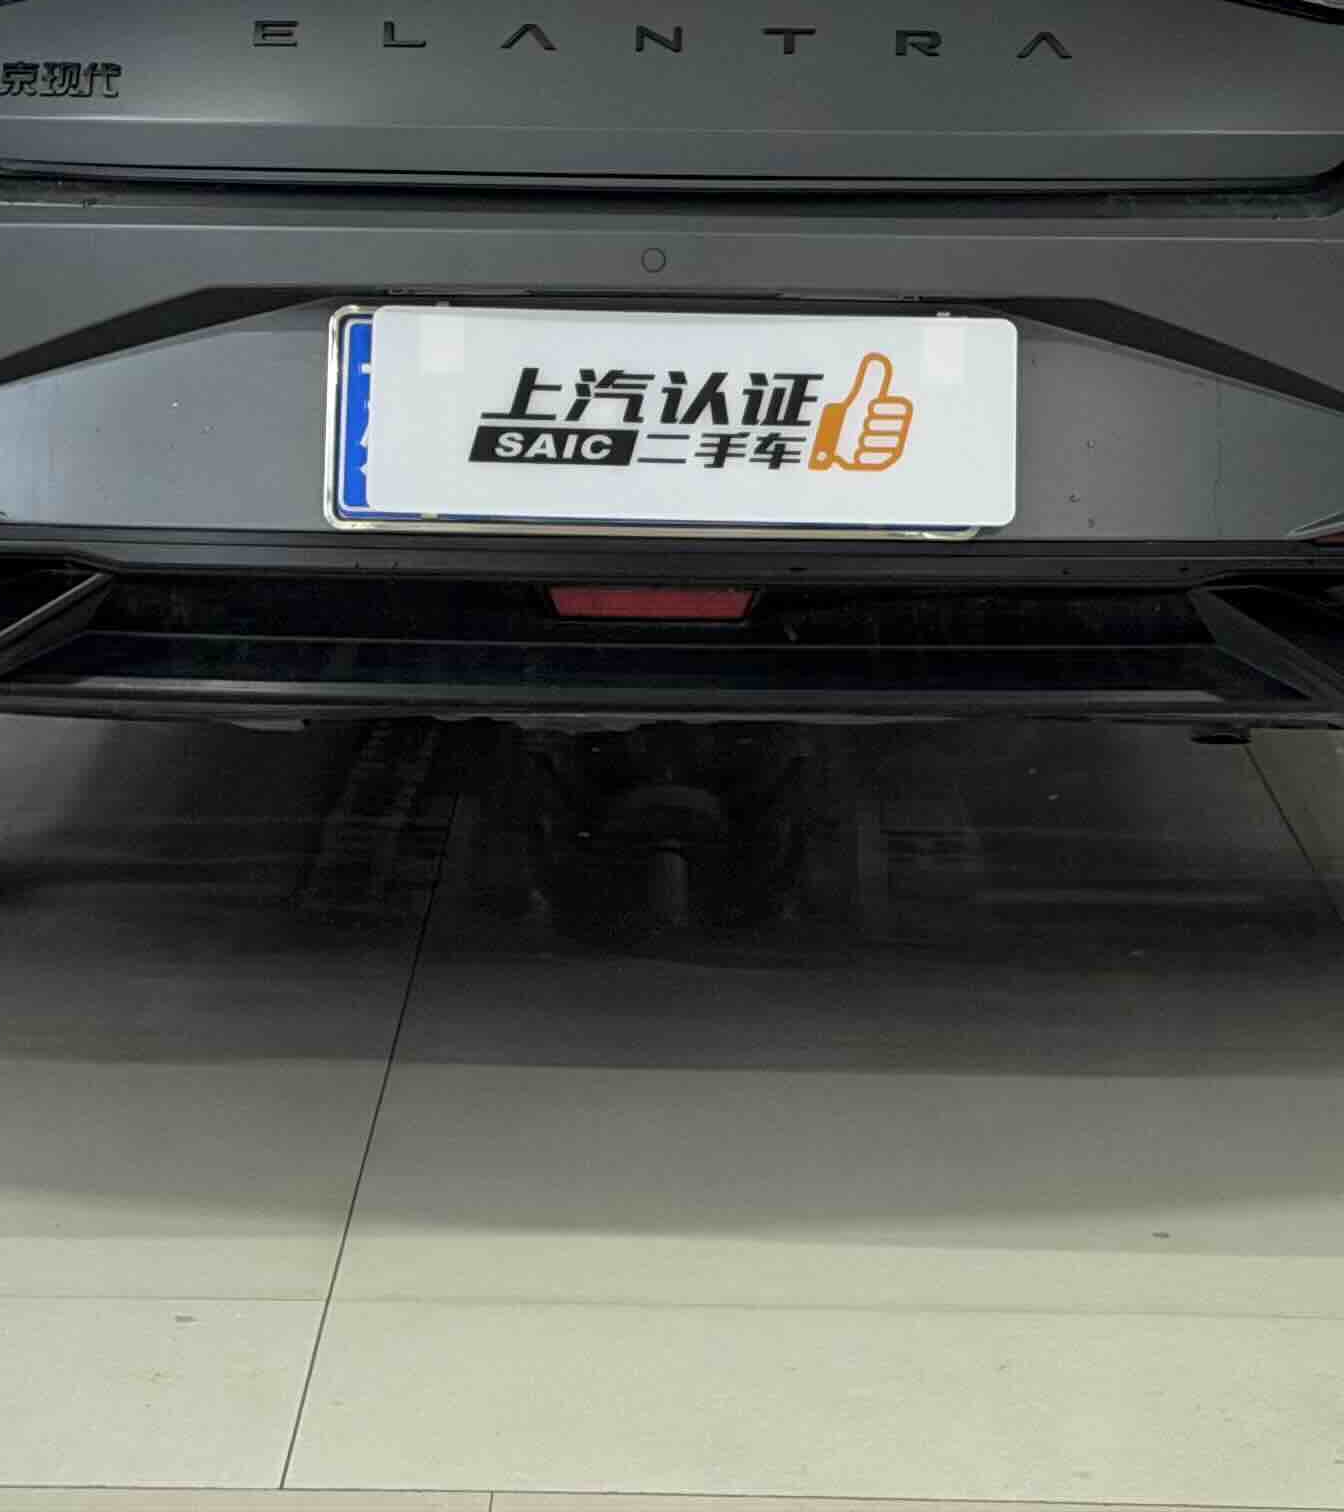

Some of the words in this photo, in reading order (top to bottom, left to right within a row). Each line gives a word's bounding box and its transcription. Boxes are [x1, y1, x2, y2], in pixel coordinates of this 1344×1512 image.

[252, 20, 1075, 59] ELANTRA
[480, 366, 825, 428] 上汽认证
[493, 431, 615, 462] SAIC
[637, 431, 808, 471] 二手车
